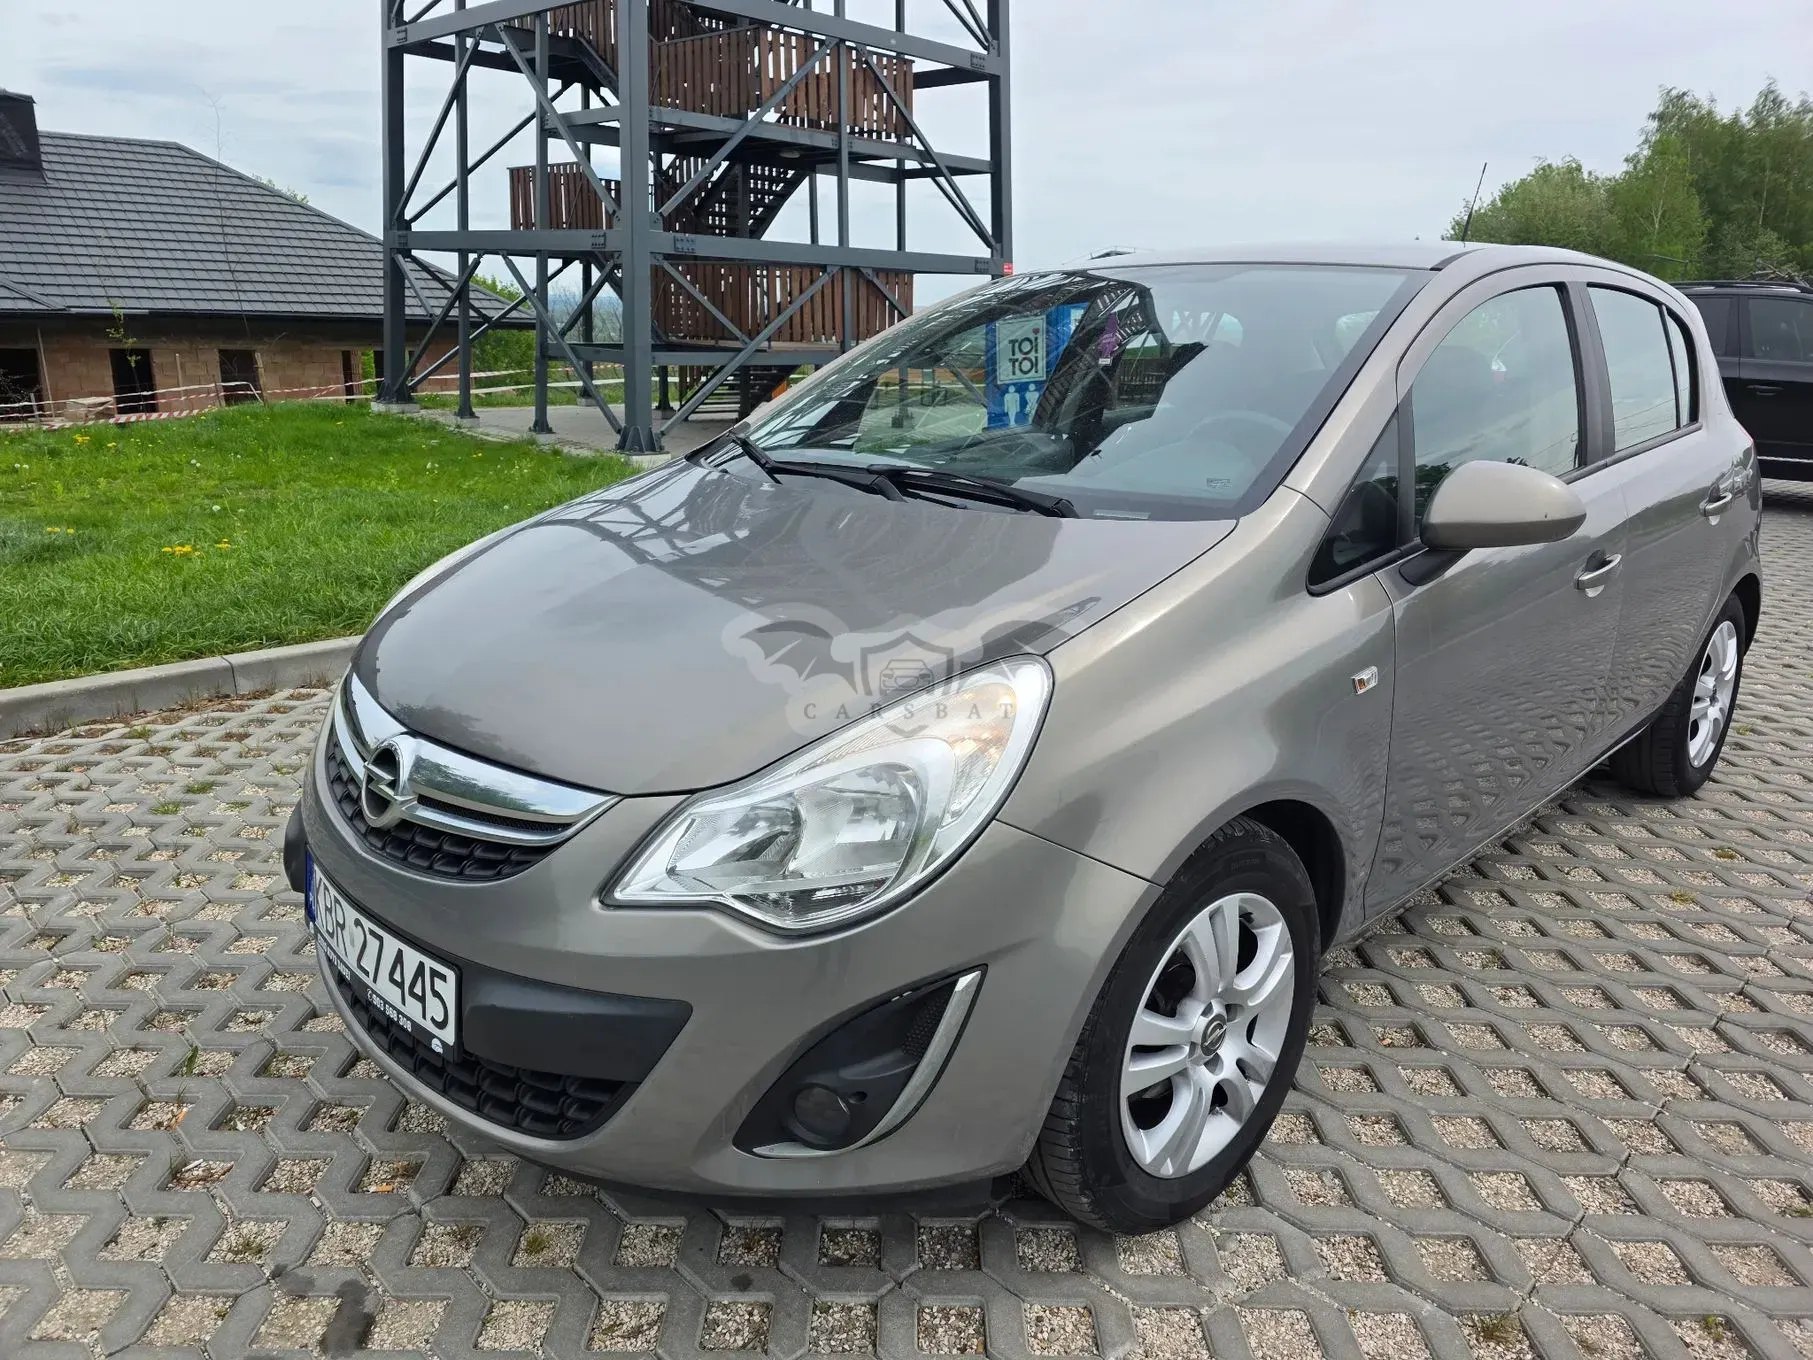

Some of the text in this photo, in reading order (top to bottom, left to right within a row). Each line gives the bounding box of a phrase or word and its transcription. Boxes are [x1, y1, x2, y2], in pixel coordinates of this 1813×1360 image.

[1008, 355, 1039, 376] TOI
[314, 868, 348, 958] KBR
[353, 917, 449, 1031] 27445
